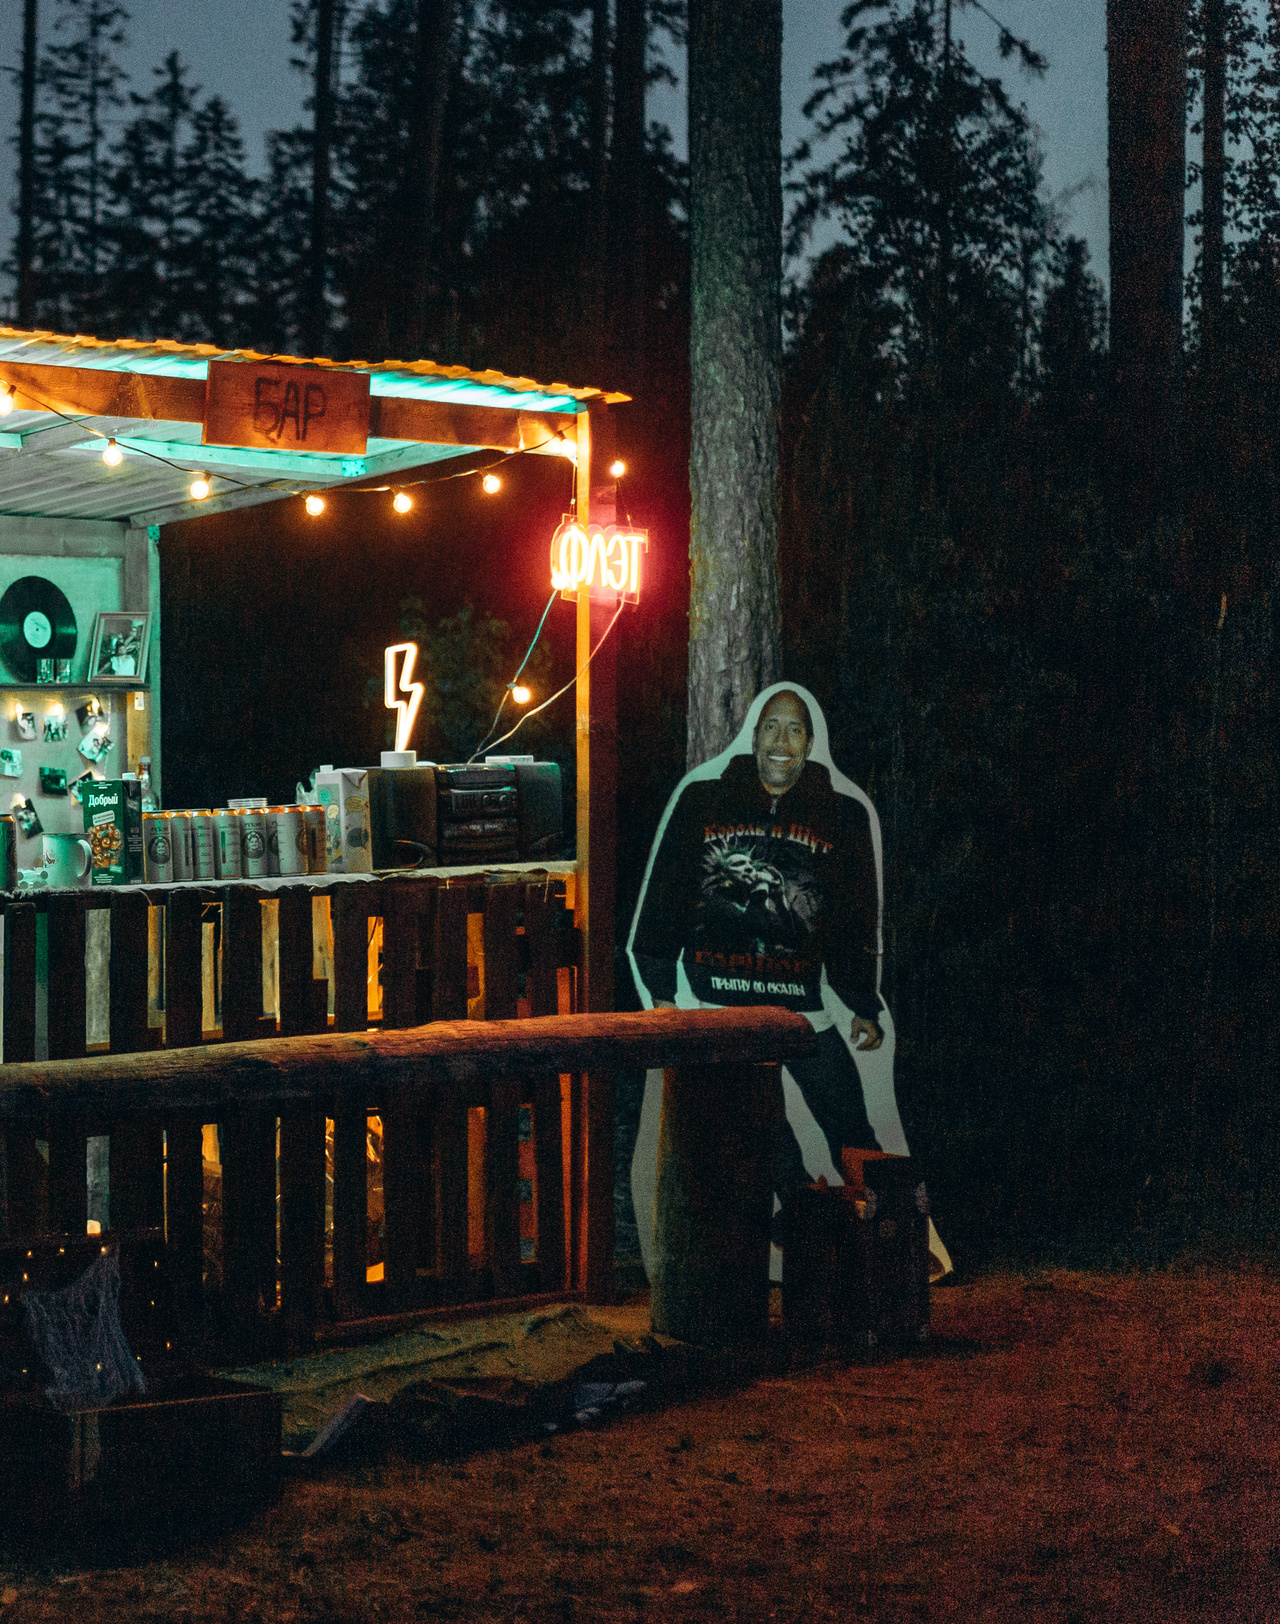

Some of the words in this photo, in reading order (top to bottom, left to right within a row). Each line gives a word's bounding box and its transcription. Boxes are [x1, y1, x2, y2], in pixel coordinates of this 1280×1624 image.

[253, 376, 327, 443] БАР
[558, 525, 645, 592] ФЛЭТ
[88, 792, 118, 807] Добрый
[711, 976, 750, 992] ПРЫГНУ
[767, 981, 806, 997] СКАЛЫ
